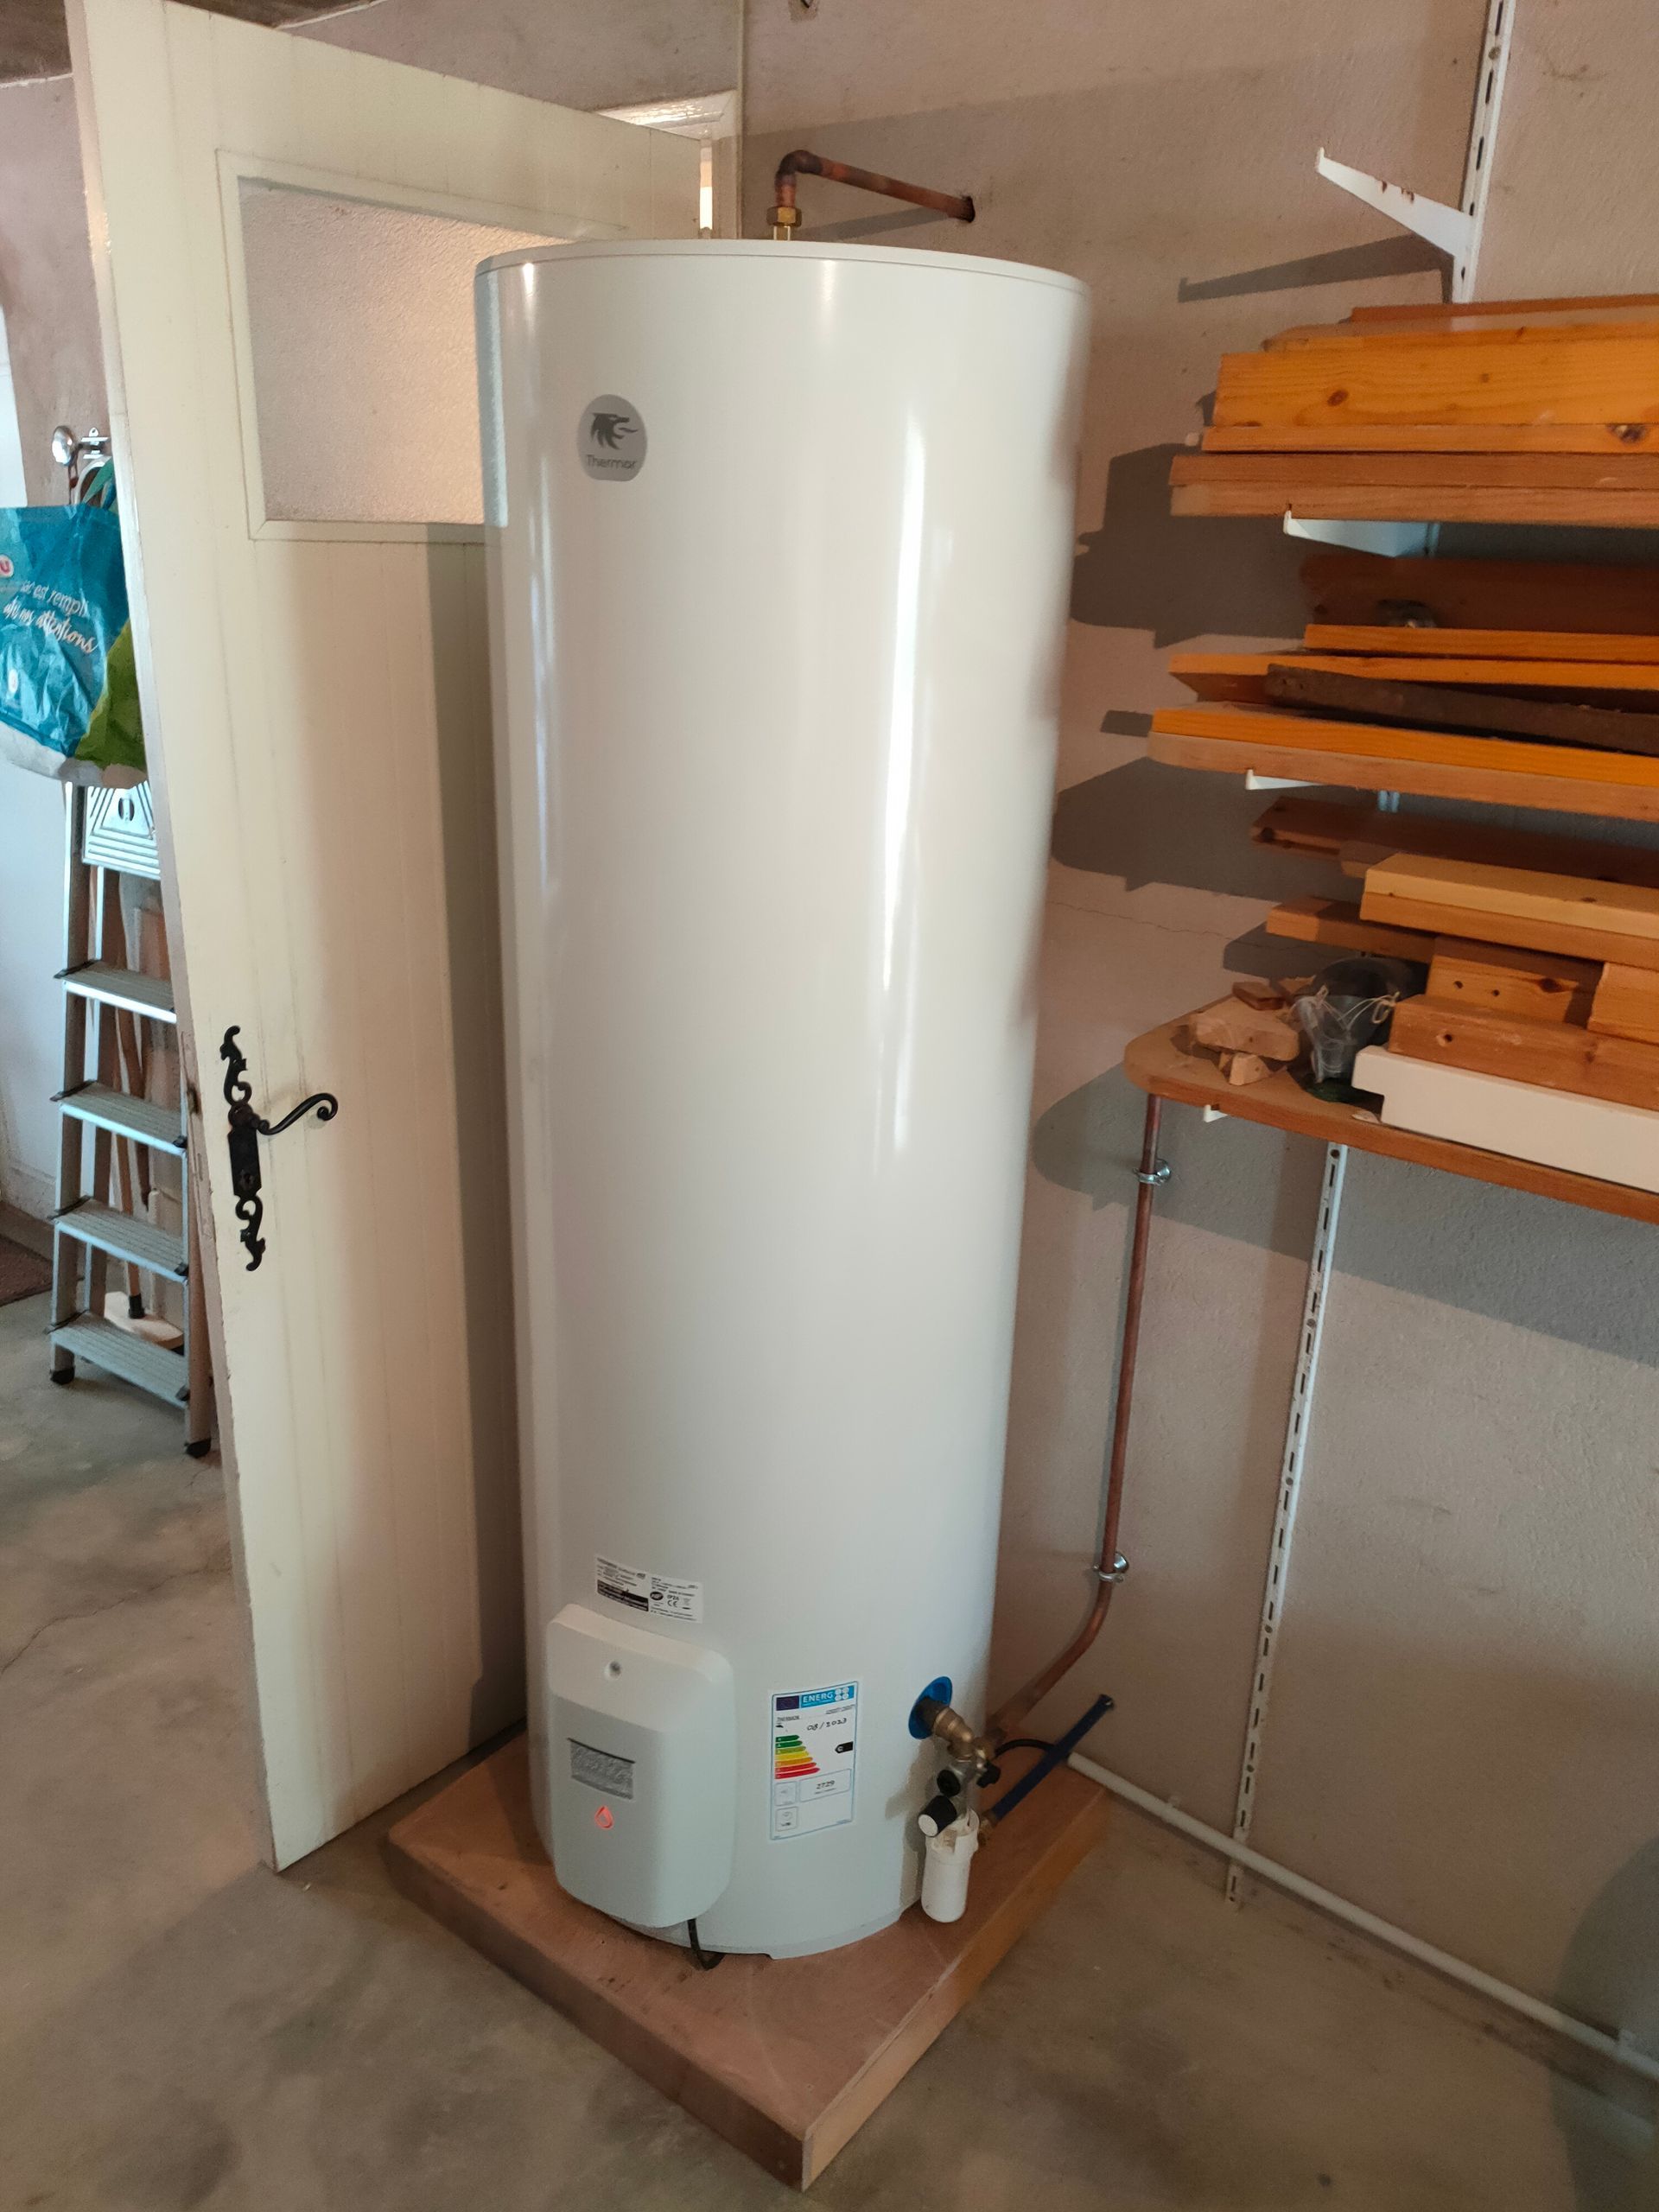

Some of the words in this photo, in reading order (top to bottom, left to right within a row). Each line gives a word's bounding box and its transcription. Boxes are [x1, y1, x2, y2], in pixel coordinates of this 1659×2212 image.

[586, 454, 638, 469] Thermor
[33, 585, 50, 602] est
[36, 610, 100, 654] attentions
[803, 1692, 833, 1703] ENERG
